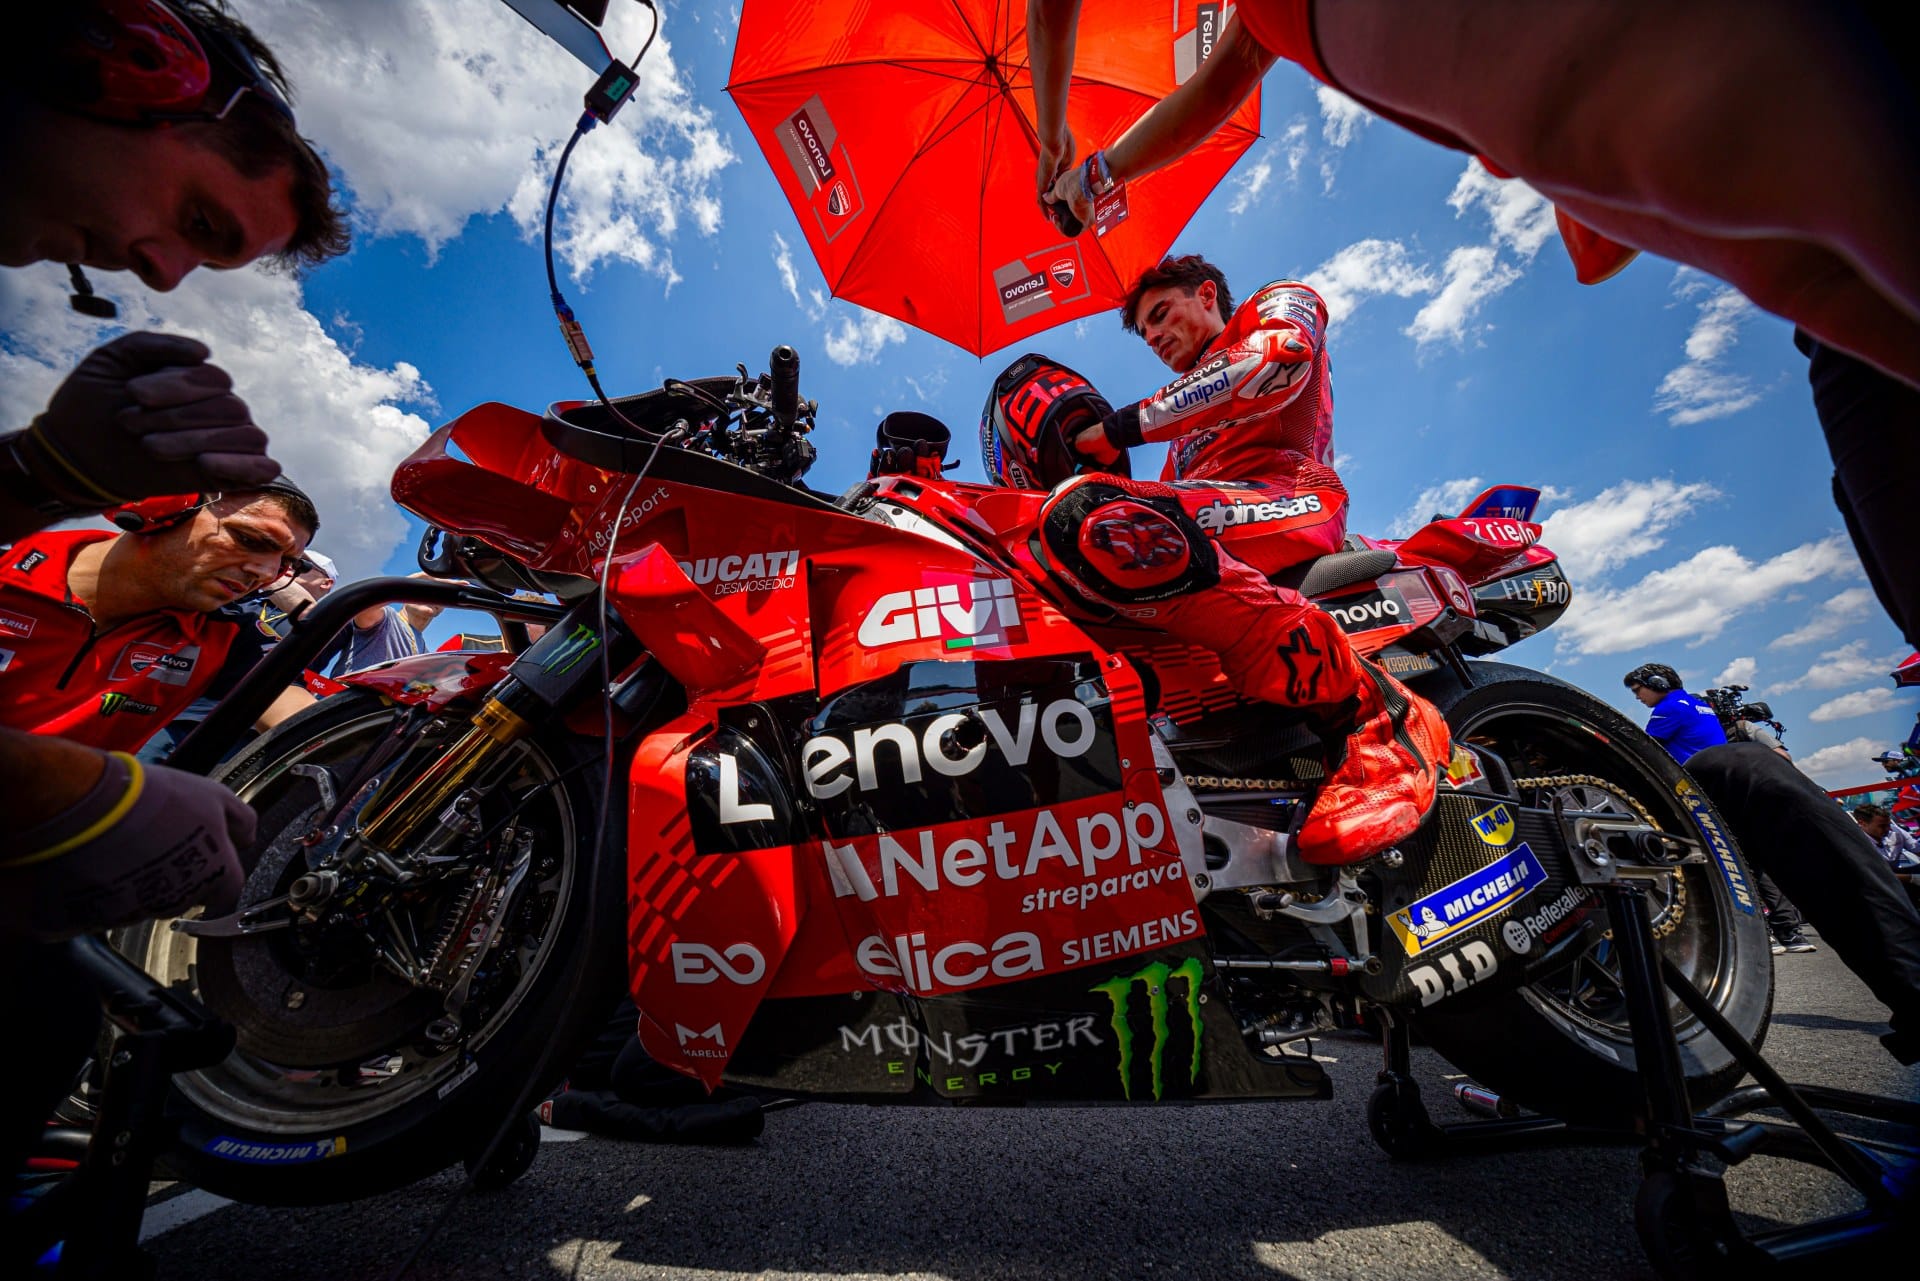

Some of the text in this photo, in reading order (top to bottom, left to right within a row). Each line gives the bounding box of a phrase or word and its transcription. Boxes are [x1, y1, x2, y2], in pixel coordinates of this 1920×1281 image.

[1165, 359, 1224, 393] Lenovo
[1173, 371, 1231, 409] Unipol
[1196, 493, 1322, 535] alpinestars
[1502, 506, 1527, 521] TIM
[20, 552, 46, 571] Lenovo
[714, 577, 795, 596] DESMOSEDICI
[857, 578, 1021, 647] GIVI
[1475, 807, 1510, 837] WD-40
[878, 801, 1166, 898] NetApp
[1696, 811, 1753, 908] MICHELIN
[1021, 860, 1183, 914] streparava
[1443, 860, 1530, 921] MICHELIN
[1062, 909, 1199, 966] SIEMENS
[856, 930, 1046, 992] elica
[682, 1048, 728, 1059] MARELLI
[837, 1015, 1105, 1068] MONSTER
[887, 1061, 1063, 1091] ENERGY
[212, 1139, 314, 1161] MICHELIN
